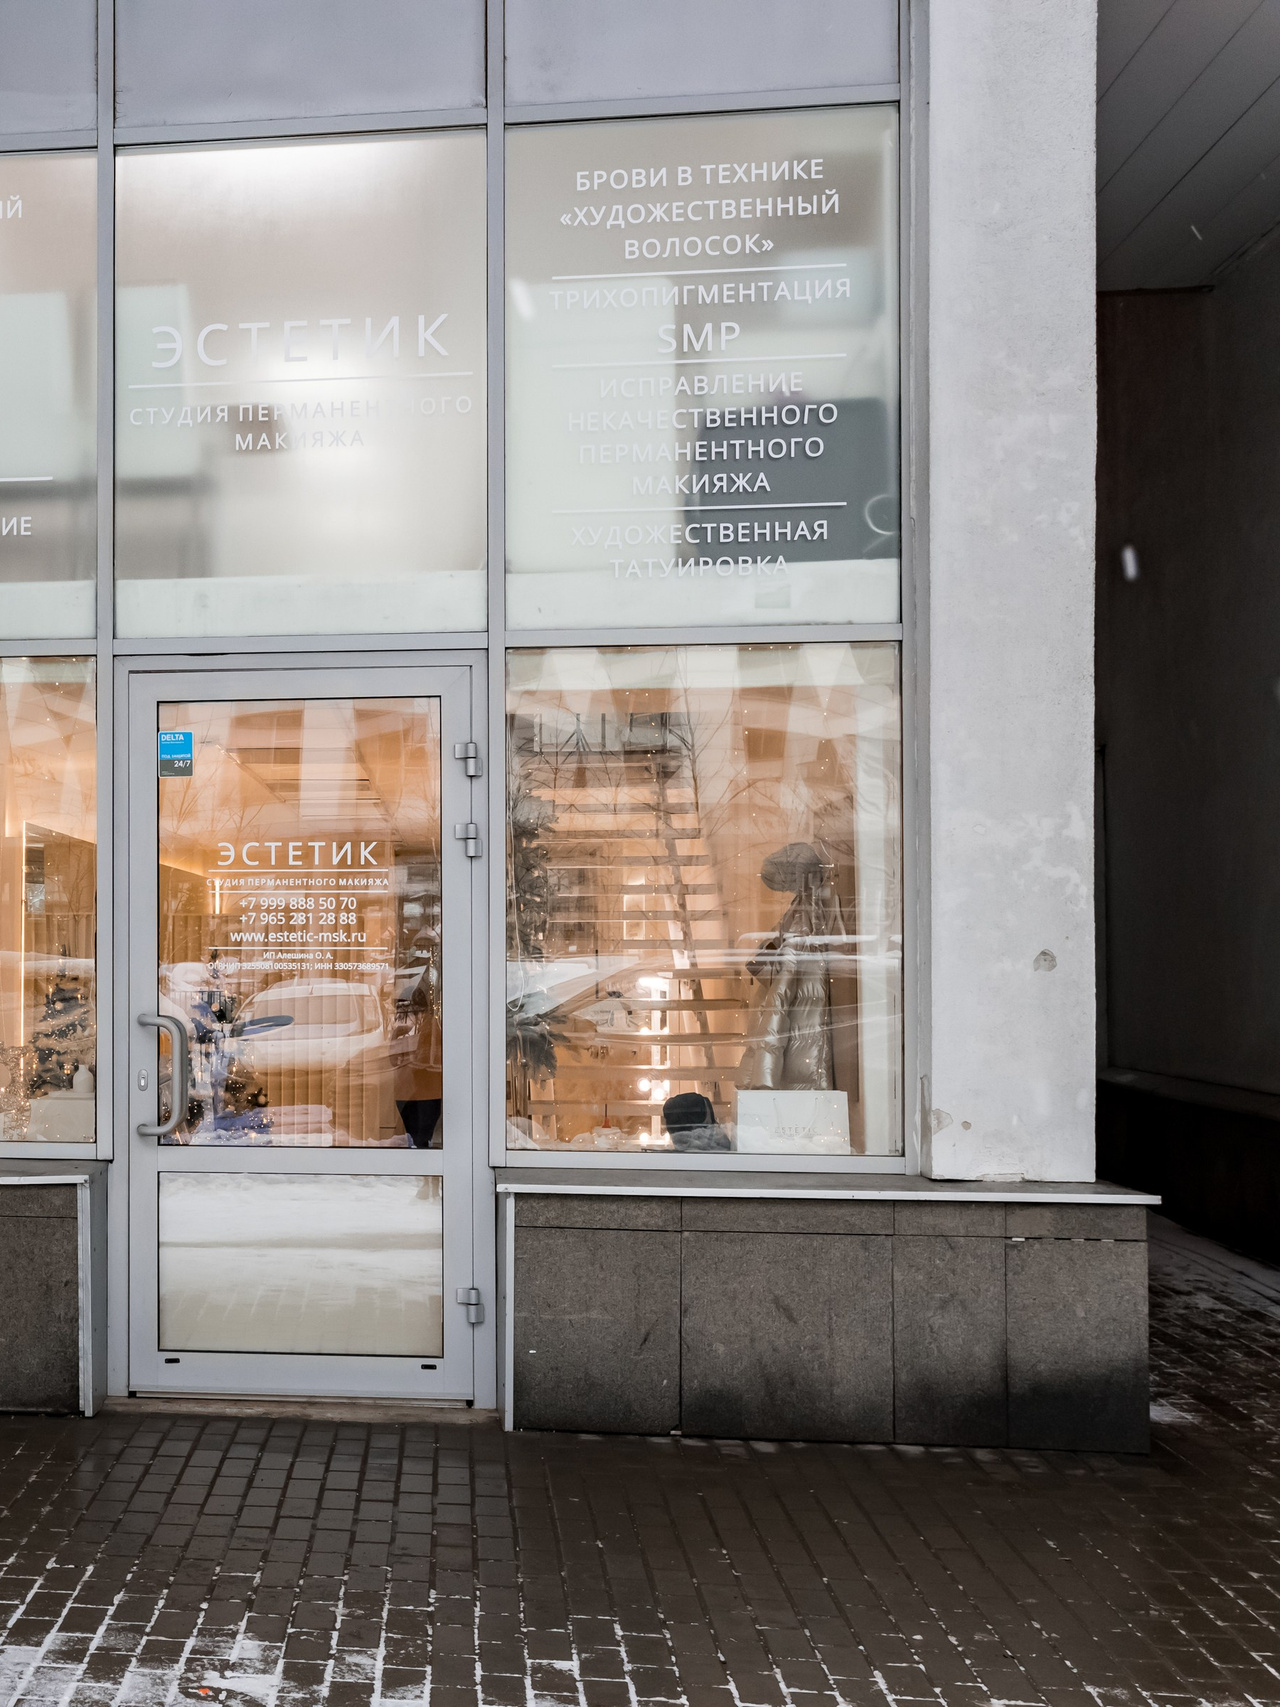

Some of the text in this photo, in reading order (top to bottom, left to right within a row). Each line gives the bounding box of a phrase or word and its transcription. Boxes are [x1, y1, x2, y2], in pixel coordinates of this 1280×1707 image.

[576, 158, 824, 191] БРОВИ В ТЕХНИКЕ
[560, 189, 840, 229] «ХУДОЖЕСТВЕННЫЙ
[624, 233, 774, 260] ВОЛОСОК»
[549, 278, 851, 311] ТРИХОПИГМЕНТАЦИЯ
[151, 313, 450, 368] ЭСТЕТИК
[658, 321, 741, 353] SMP
[600, 371, 803, 399] ИСПРАВЛЕНИЕ
[129, 395, 473, 427] СТУДИЯ ПЕРМАНЕНОГО
[568, 402, 839, 432] НЕКАЧЕСТВЕННОГО
[235, 429, 365, 451] МАКИЯЖА
[579, 436, 825, 465] ПЕРМАНЕНТНОГО
[632, 472, 771, 496] МАКИЯЖА
[571, 519, 829, 550] ХУДОЖЕСТВЕННАЯ
[610, 555, 788, 579] ТАТУИРОВКА
[174, 760, 191, 768] 24/7
[217, 841, 378, 866] ЭСТЕТИК
[206, 878, 389, 887] СТУДИЯ ПЕРМАНЕНТНОГО МАКИЯЖА
[239, 897, 357, 910] +7 999 888 50 70
[239, 912, 357, 925] +7 965 281 28 88
[230, 930, 366, 943] www.estetic-msk.ru
[314, 962, 333, 970] ИНН
